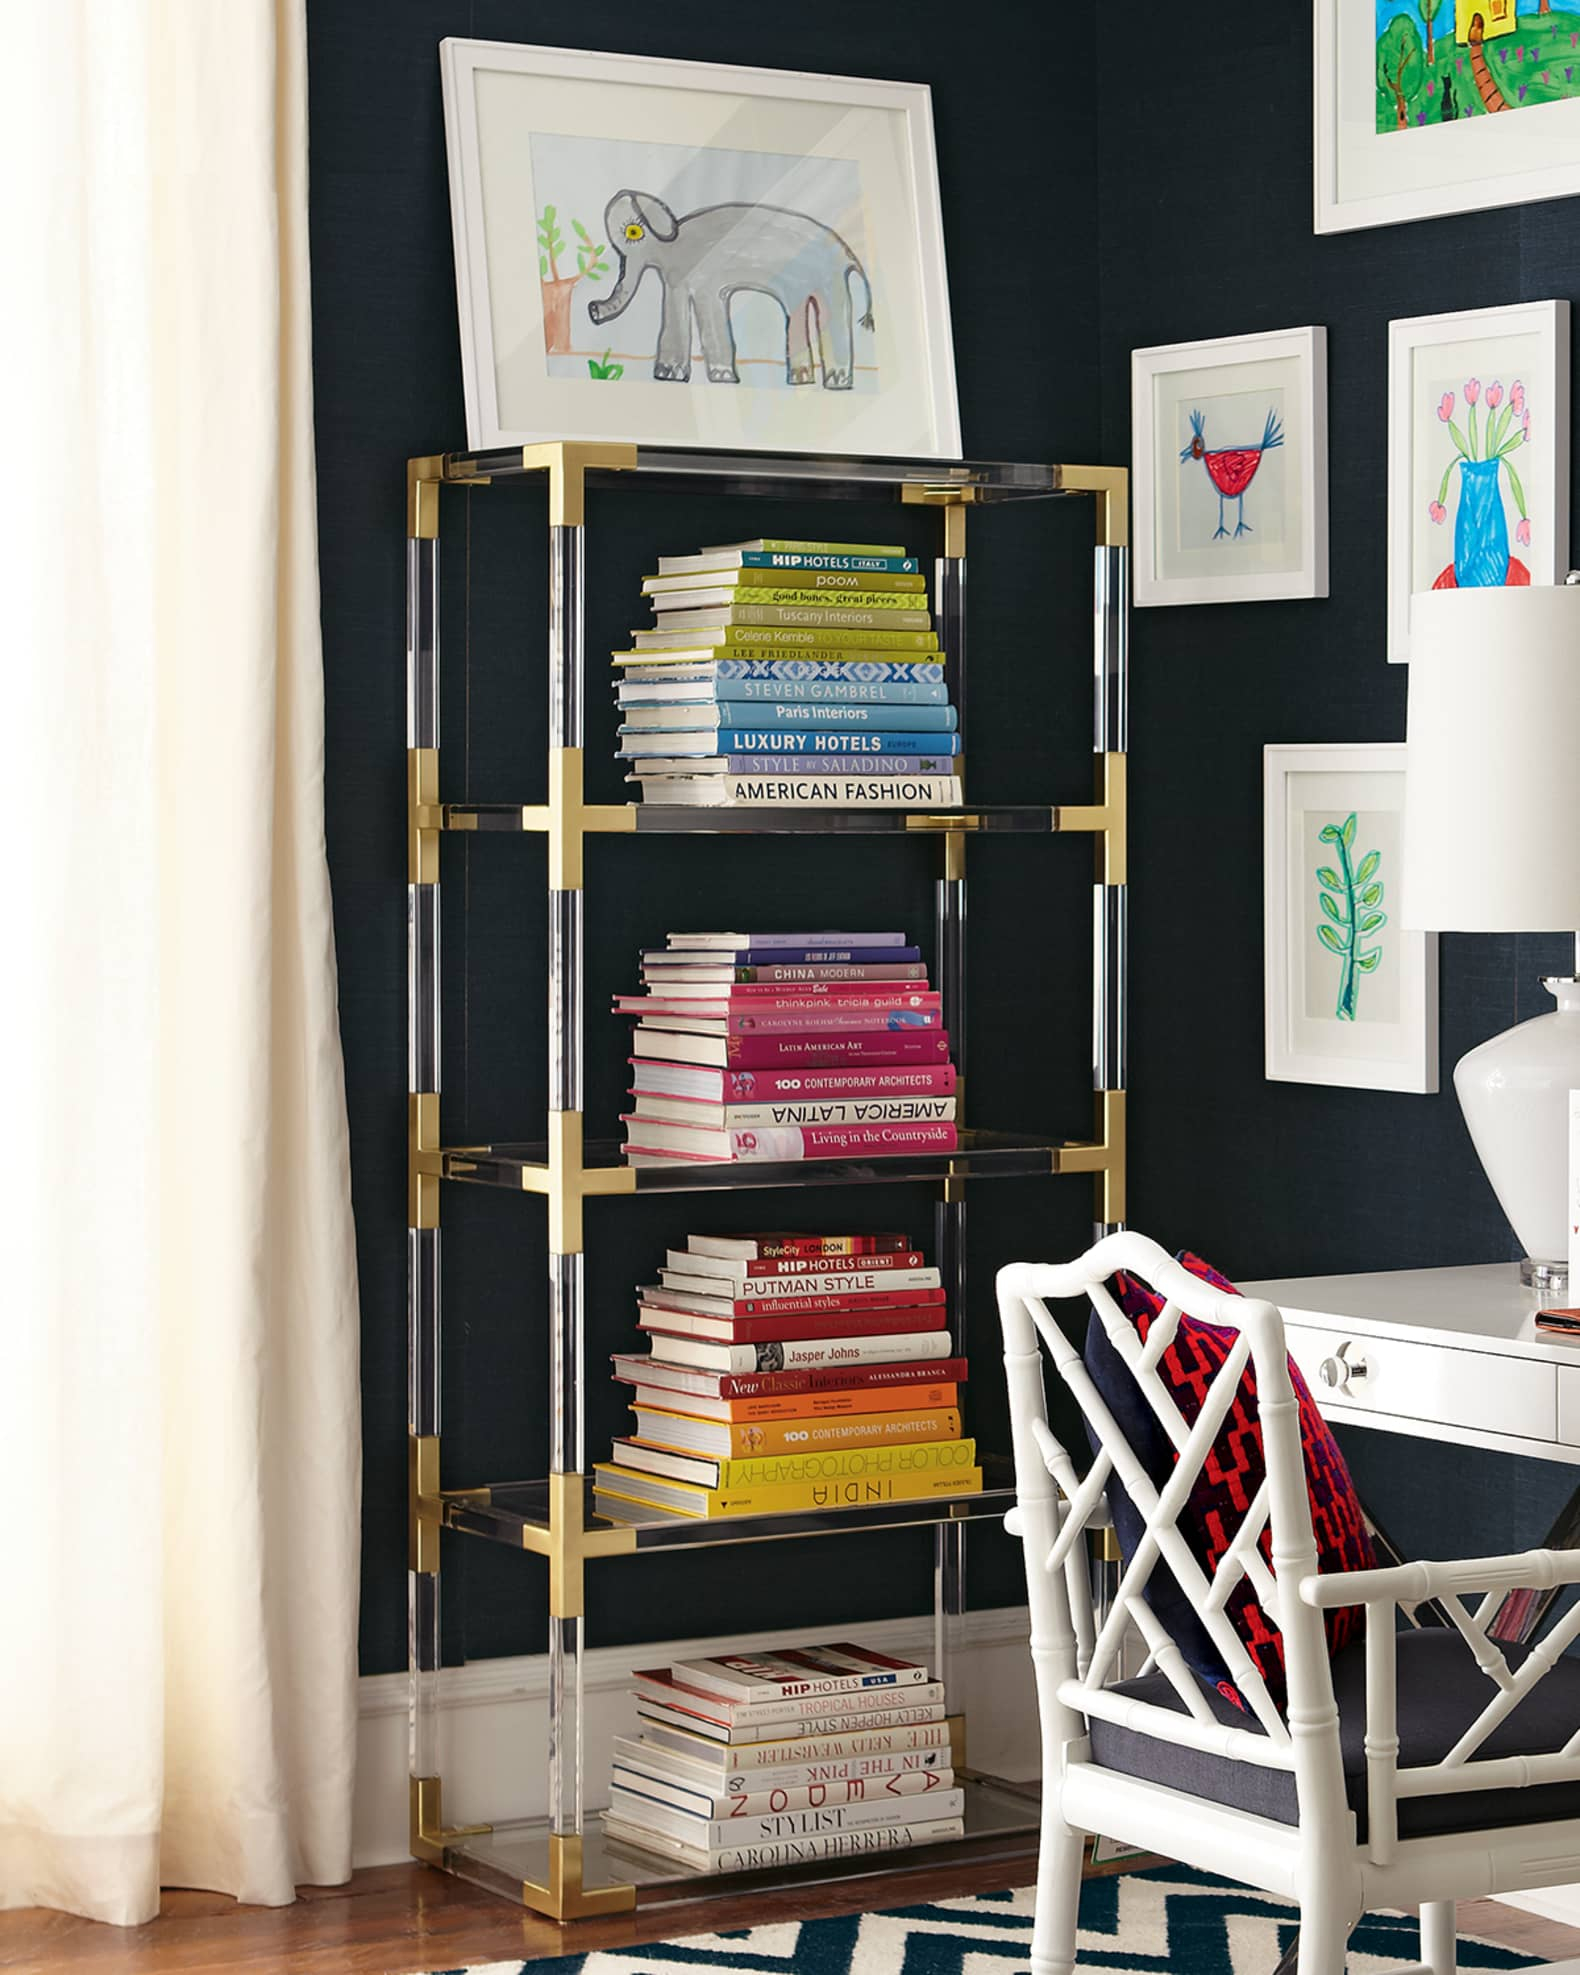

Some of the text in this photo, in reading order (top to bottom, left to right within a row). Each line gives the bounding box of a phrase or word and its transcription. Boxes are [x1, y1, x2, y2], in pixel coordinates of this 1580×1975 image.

[772, 554, 801, 566] HIP
[803, 556, 849, 569] HOTELS
[858, 559, 881, 568] ITALY
[772, 591, 798, 602] good
[836, 594, 863, 604] great
[866, 594, 898, 605] pieces
[776, 608, 873, 624] Tuscany Interiors
[774, 631, 815, 643] Kemble
[733, 649, 843, 660] LEE FRIEDLANDER
[744, 682, 887, 699] STEVEN GAMBREL
[776, 704, 868, 720] Paris Interiors
[734, 733, 807, 750] LUXURY
[815, 735, 881, 751] HOTELS
[752, 758, 801, 772] STYLE
[822, 758, 908, 772] SALADINO
[735, 783, 932, 800] AMERICAN FASHION
[774, 968, 865, 979] CHINA MODERN
[838, 998, 869, 1008] tricia
[874, 997, 902, 1008] guild
[775, 1074, 933, 1090] 100 CONTEMPORARY ARCHITECTS
[772, 1102, 947, 1123] AMERICA LATINA
[811, 1127, 948, 1148] Living in the Countryside
[763, 1243, 843, 1257] StyleCity LONDON
[777, 1258, 890, 1273] HIP HOTELS ORIENT
[743, 1276, 875, 1296] PUTMAN STYLE
[762, 1296, 812, 1311] influential
[814, 1295, 841, 1309] styles
[789, 1350, 825, 1364] Jasper
[828, 1347, 860, 1360] Johns
[868, 1368, 946, 1382] ALESSANDRA BRANCA
[728, 1374, 865, 1396] New Classic Interiors
[784, 1420, 938, 1442] 100 CONTEMPORARY ARCHITECTS
[736, 1452, 893, 1484] PHOTOGRAPHY
[813, 1479, 893, 1505] INDIA
[781, 1677, 889, 1696] HIP HOTELS USA
[800, 1692, 906, 1715] TROPICAL HOUSES
[798, 1707, 933, 1735] KELLY HOPPEN STYLE
[852, 1735, 892, 1753] KELLY
[757, 1742, 844, 1764] WEARSTLER
[902, 1754, 920, 1769] IN
[807, 1763, 849, 1782] PINK
[860, 1758, 895, 1775] THE
[760, 1808, 847, 1838] STYLIST
[718, 1827, 913, 1869] CAROLINA HERRERA
